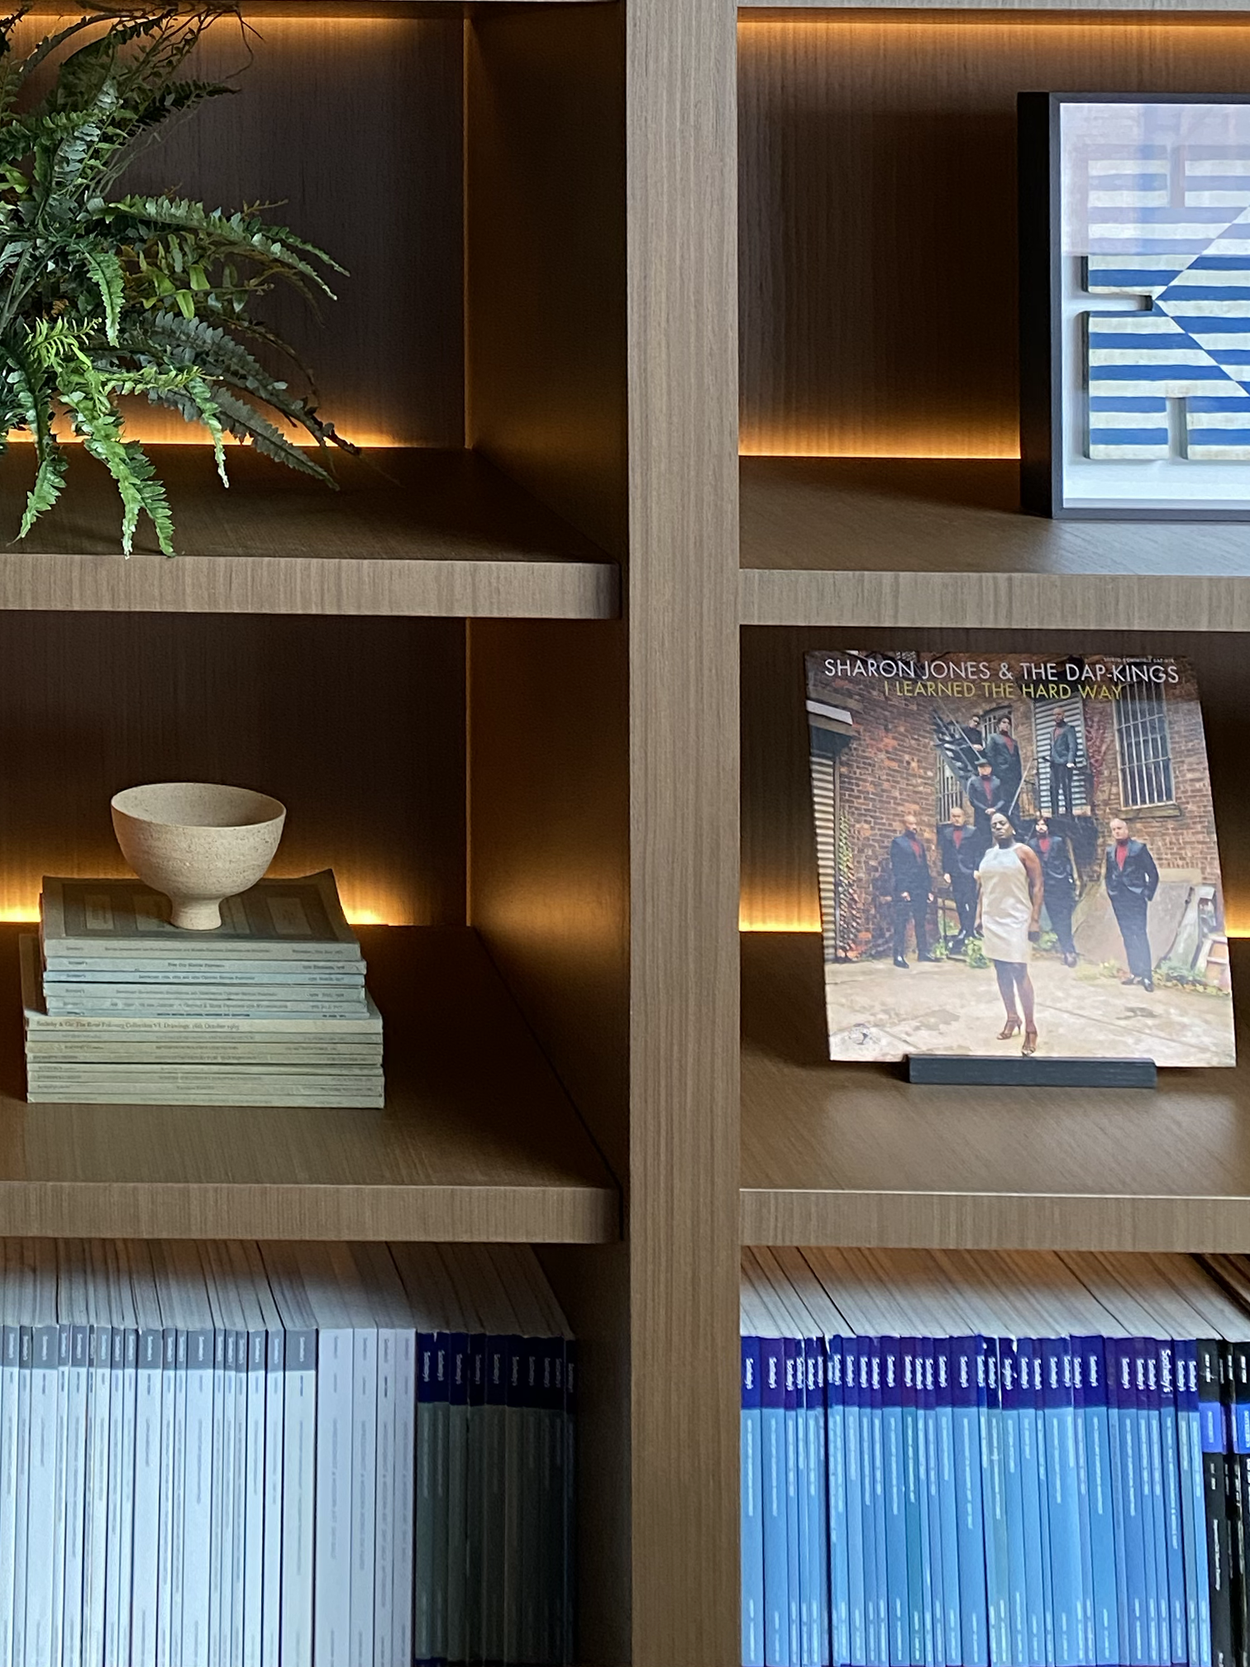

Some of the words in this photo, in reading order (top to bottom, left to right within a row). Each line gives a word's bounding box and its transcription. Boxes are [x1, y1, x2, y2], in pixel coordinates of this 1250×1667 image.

[824, 659, 916, 678] SHARON
[922, 660, 990, 680] JONES
[999, 662, 1013, 680] &
[1020, 663, 1058, 680] THE
[1066, 664, 1178, 684] DAP-KINGS
[884, 681, 888, 696] I
[896, 681, 976, 697] LEARNED
[981, 682, 1014, 698] THE
[1022, 684, 1071, 699] HARD
[1079, 684, 1122, 700] WAY
[1161, 1350, 1173, 1392] Sotheby's
